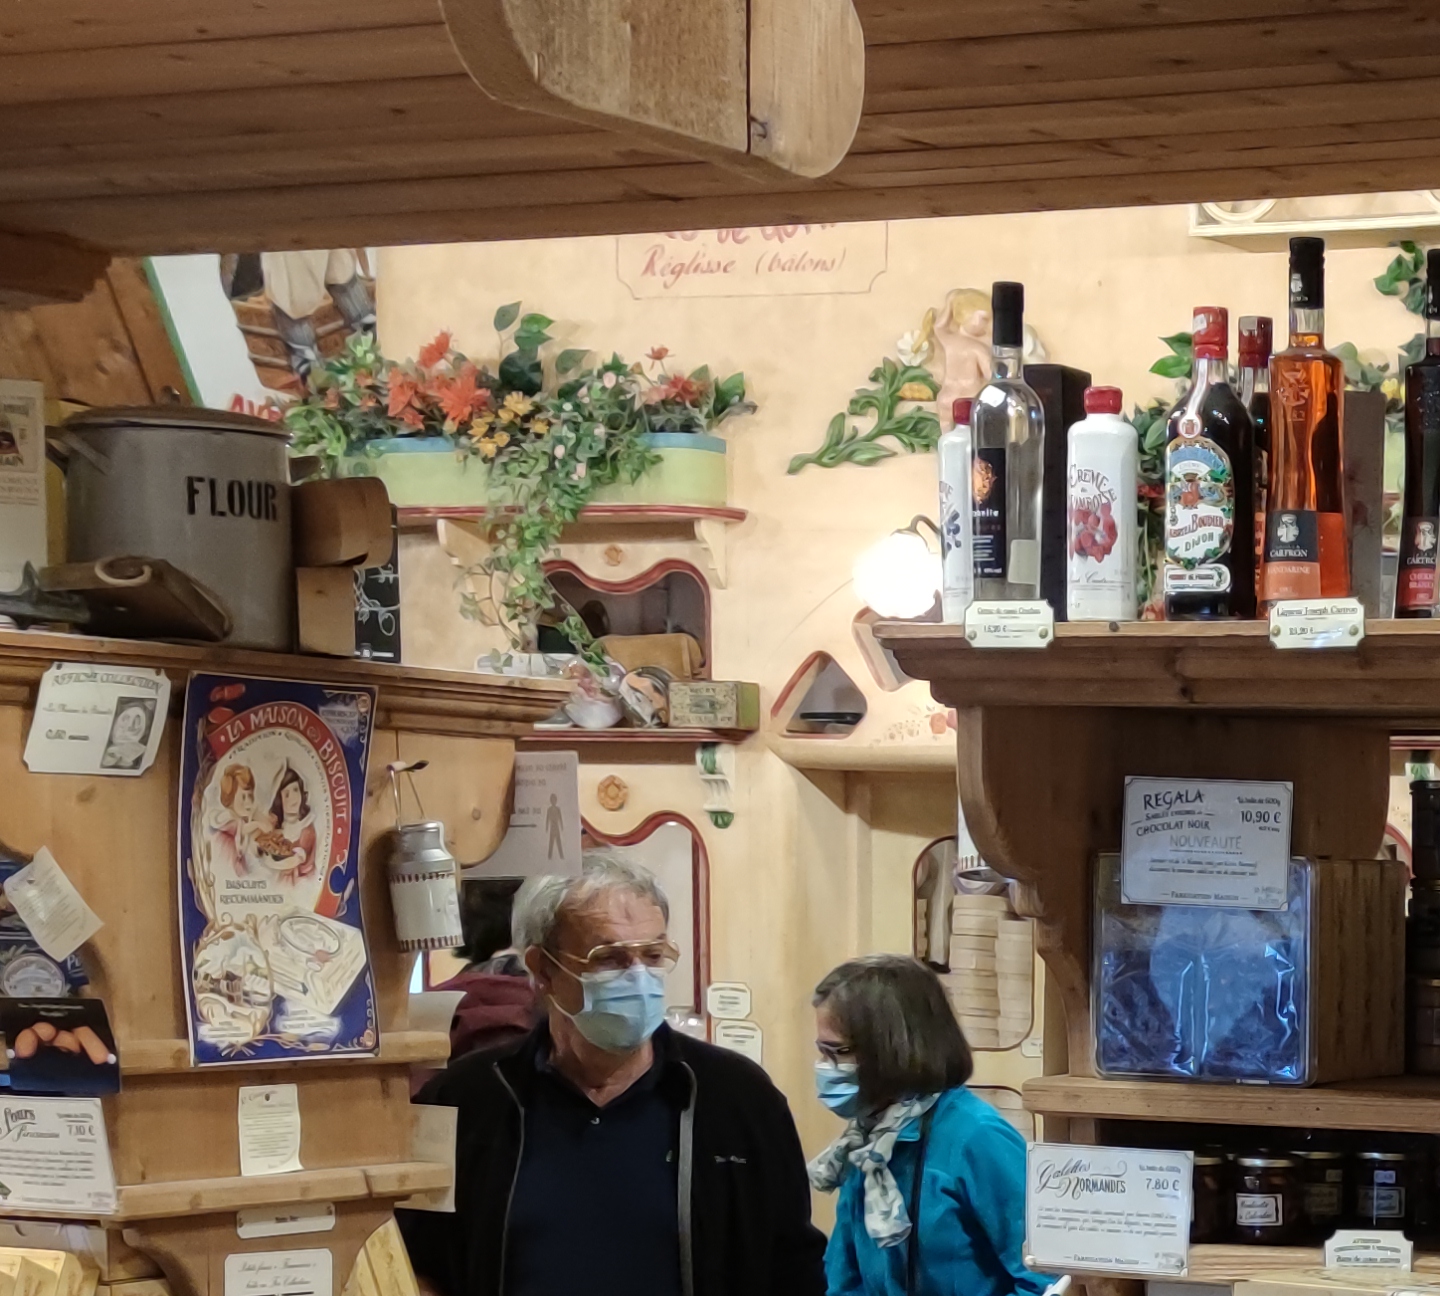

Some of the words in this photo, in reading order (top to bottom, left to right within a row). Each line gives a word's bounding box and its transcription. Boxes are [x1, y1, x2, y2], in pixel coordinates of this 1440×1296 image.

[186, 475, 278, 521] FLOUR
[224, 720, 246, 743] LA
[249, 706, 308, 731] MAISON
[318, 742, 349, 821] BISCUIT
[1143, 789, 1204, 811] REGALA
[1241, 811, 1271, 824] 10,90
[1273, 811, 1282, 824] €
[1136, 820, 1185, 837] CHOCOLAT
[1187, 820, 1211, 831] NOIR
[1169, 834, 1242, 849] NOUVEAUTÉ
